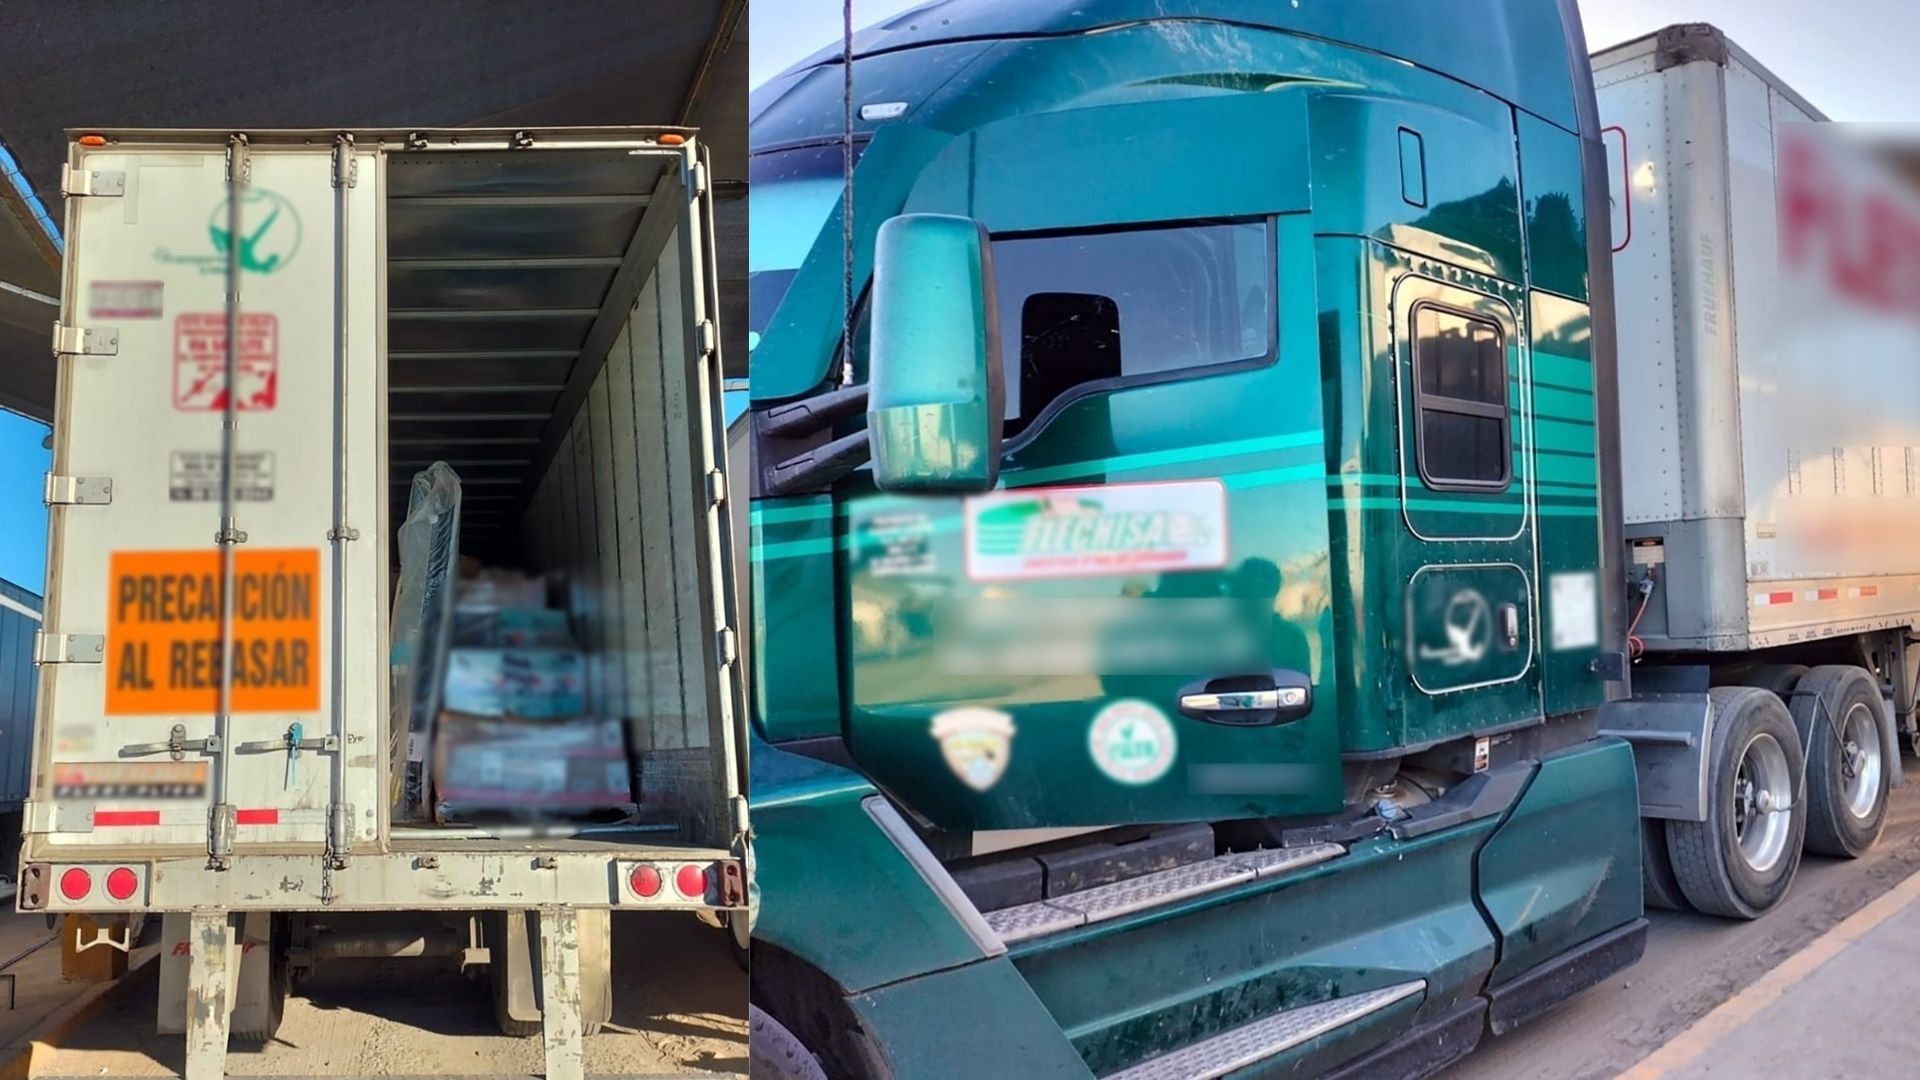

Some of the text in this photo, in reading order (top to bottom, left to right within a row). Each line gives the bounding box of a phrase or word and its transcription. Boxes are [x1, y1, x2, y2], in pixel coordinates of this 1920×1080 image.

[1699, 231, 1718, 337] FRUEHAUF
[116, 637, 310, 691] AL REBASAR
